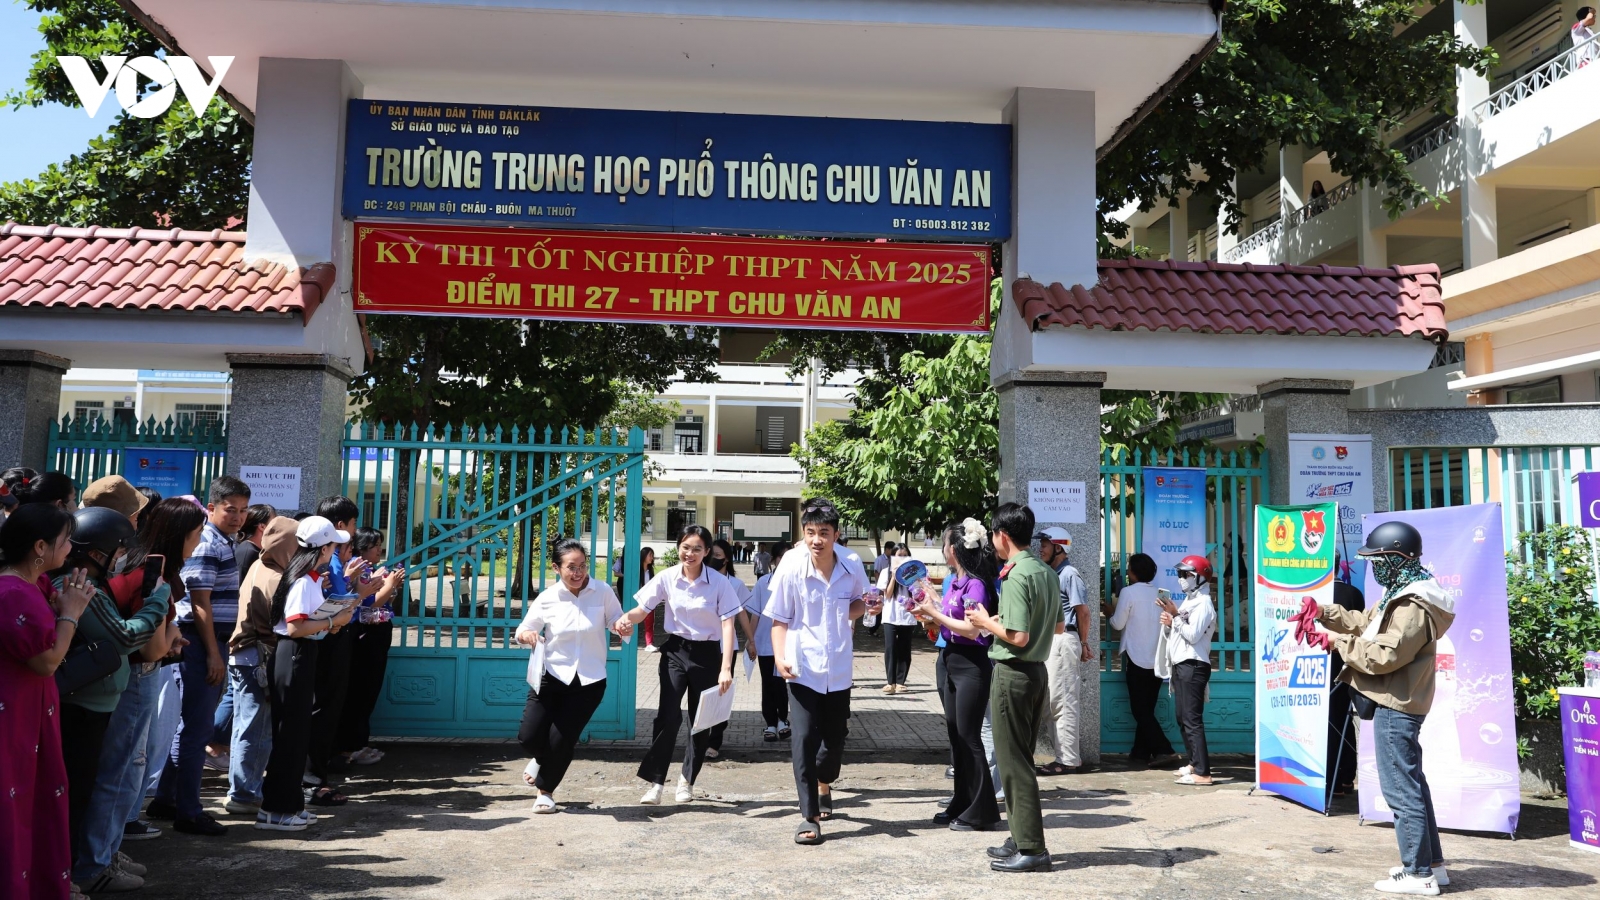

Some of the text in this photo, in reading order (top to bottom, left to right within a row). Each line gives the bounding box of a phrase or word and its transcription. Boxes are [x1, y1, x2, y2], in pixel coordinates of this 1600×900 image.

[370, 101, 382, 115] ỦY
[388, 105, 409, 116] BAN
[413, 106, 441, 117] NHÂN
[446, 106, 466, 118] DÂN
[472, 106, 494, 119] TỈNH
[391, 117, 519, 138] SỞ GIÁO DỤC VÀ ĐÀO TẠO
[366, 137, 991, 208] TRƯỜNG TRUNG HỌC PHỔ THÔNG CHU VĂN AN
[386, 200, 405, 211] 249
[410, 202, 435, 212] PHAN
[439, 200, 456, 215] BỘI
[460, 201, 487, 214] CHÂU
[495, 202, 521, 215] BUÔN
[528, 205, 543, 216] MA
[546, 203, 576, 220] THUỘT
[915, 219, 967, 230] 05003.812
[970, 221, 990, 231] 382
[375, 236, 971, 285] KỲ THI TỐT NGHIỆP THPT NĂM 2025
[446, 272, 521, 306] ĐIỂM
[530, 284, 575, 308] THI
[584, 286, 620, 310] 27
[649, 288, 720, 314] THPT
[728, 291, 785, 316] CHU
[795, 290, 852, 318] VĂN
[861, 296, 901, 319] AN
[1342, 523, 1362, 534] 202
[1165, 568, 1178, 577] TÂ
[1296, 657, 1325, 685] 2025
